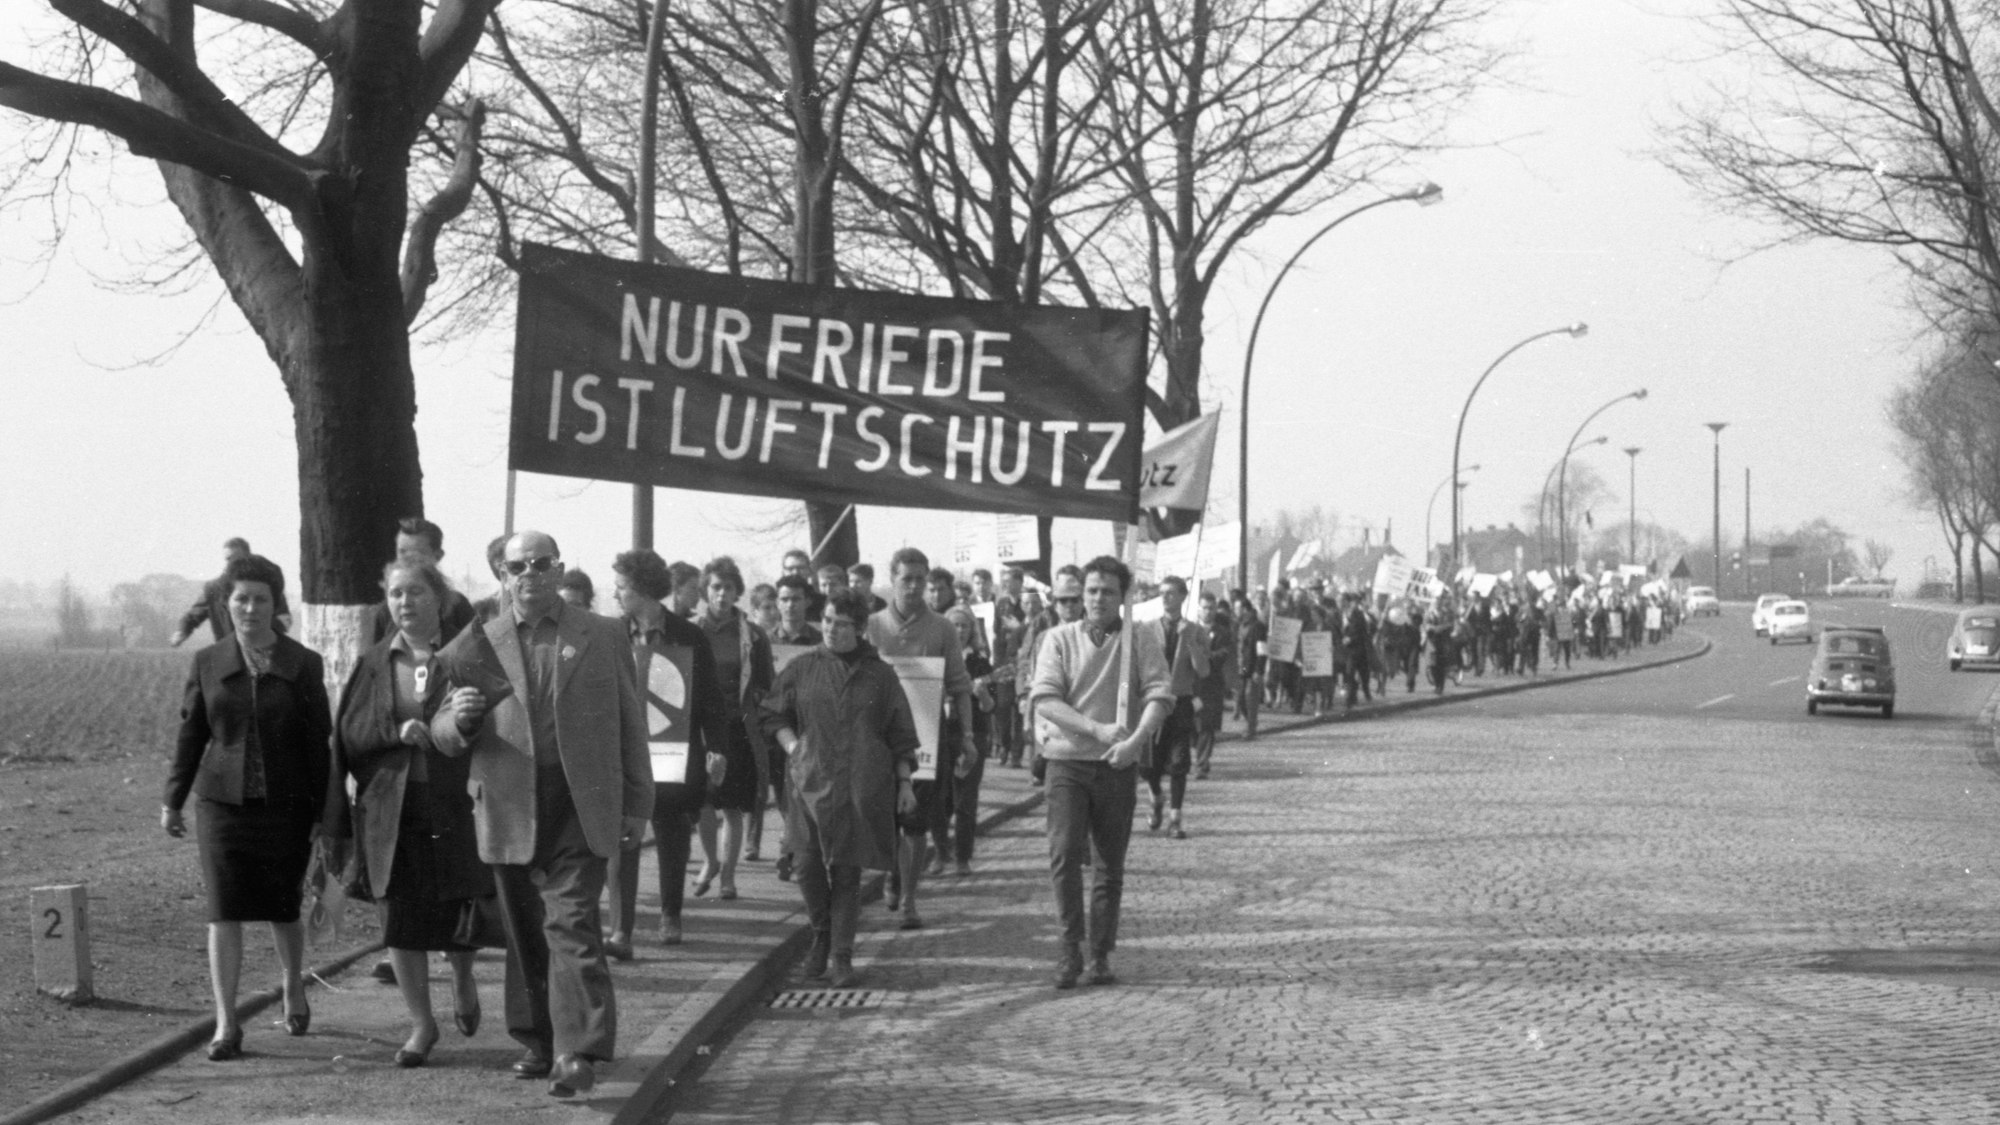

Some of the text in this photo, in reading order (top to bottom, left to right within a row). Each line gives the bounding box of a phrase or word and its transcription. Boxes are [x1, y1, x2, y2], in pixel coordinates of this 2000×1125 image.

[620, 293, 1011, 402] NUR FRIEDE
[548, 370, 1126, 490] IST LUFTSCHUTZ
[44, 908, 62, 938] 2
